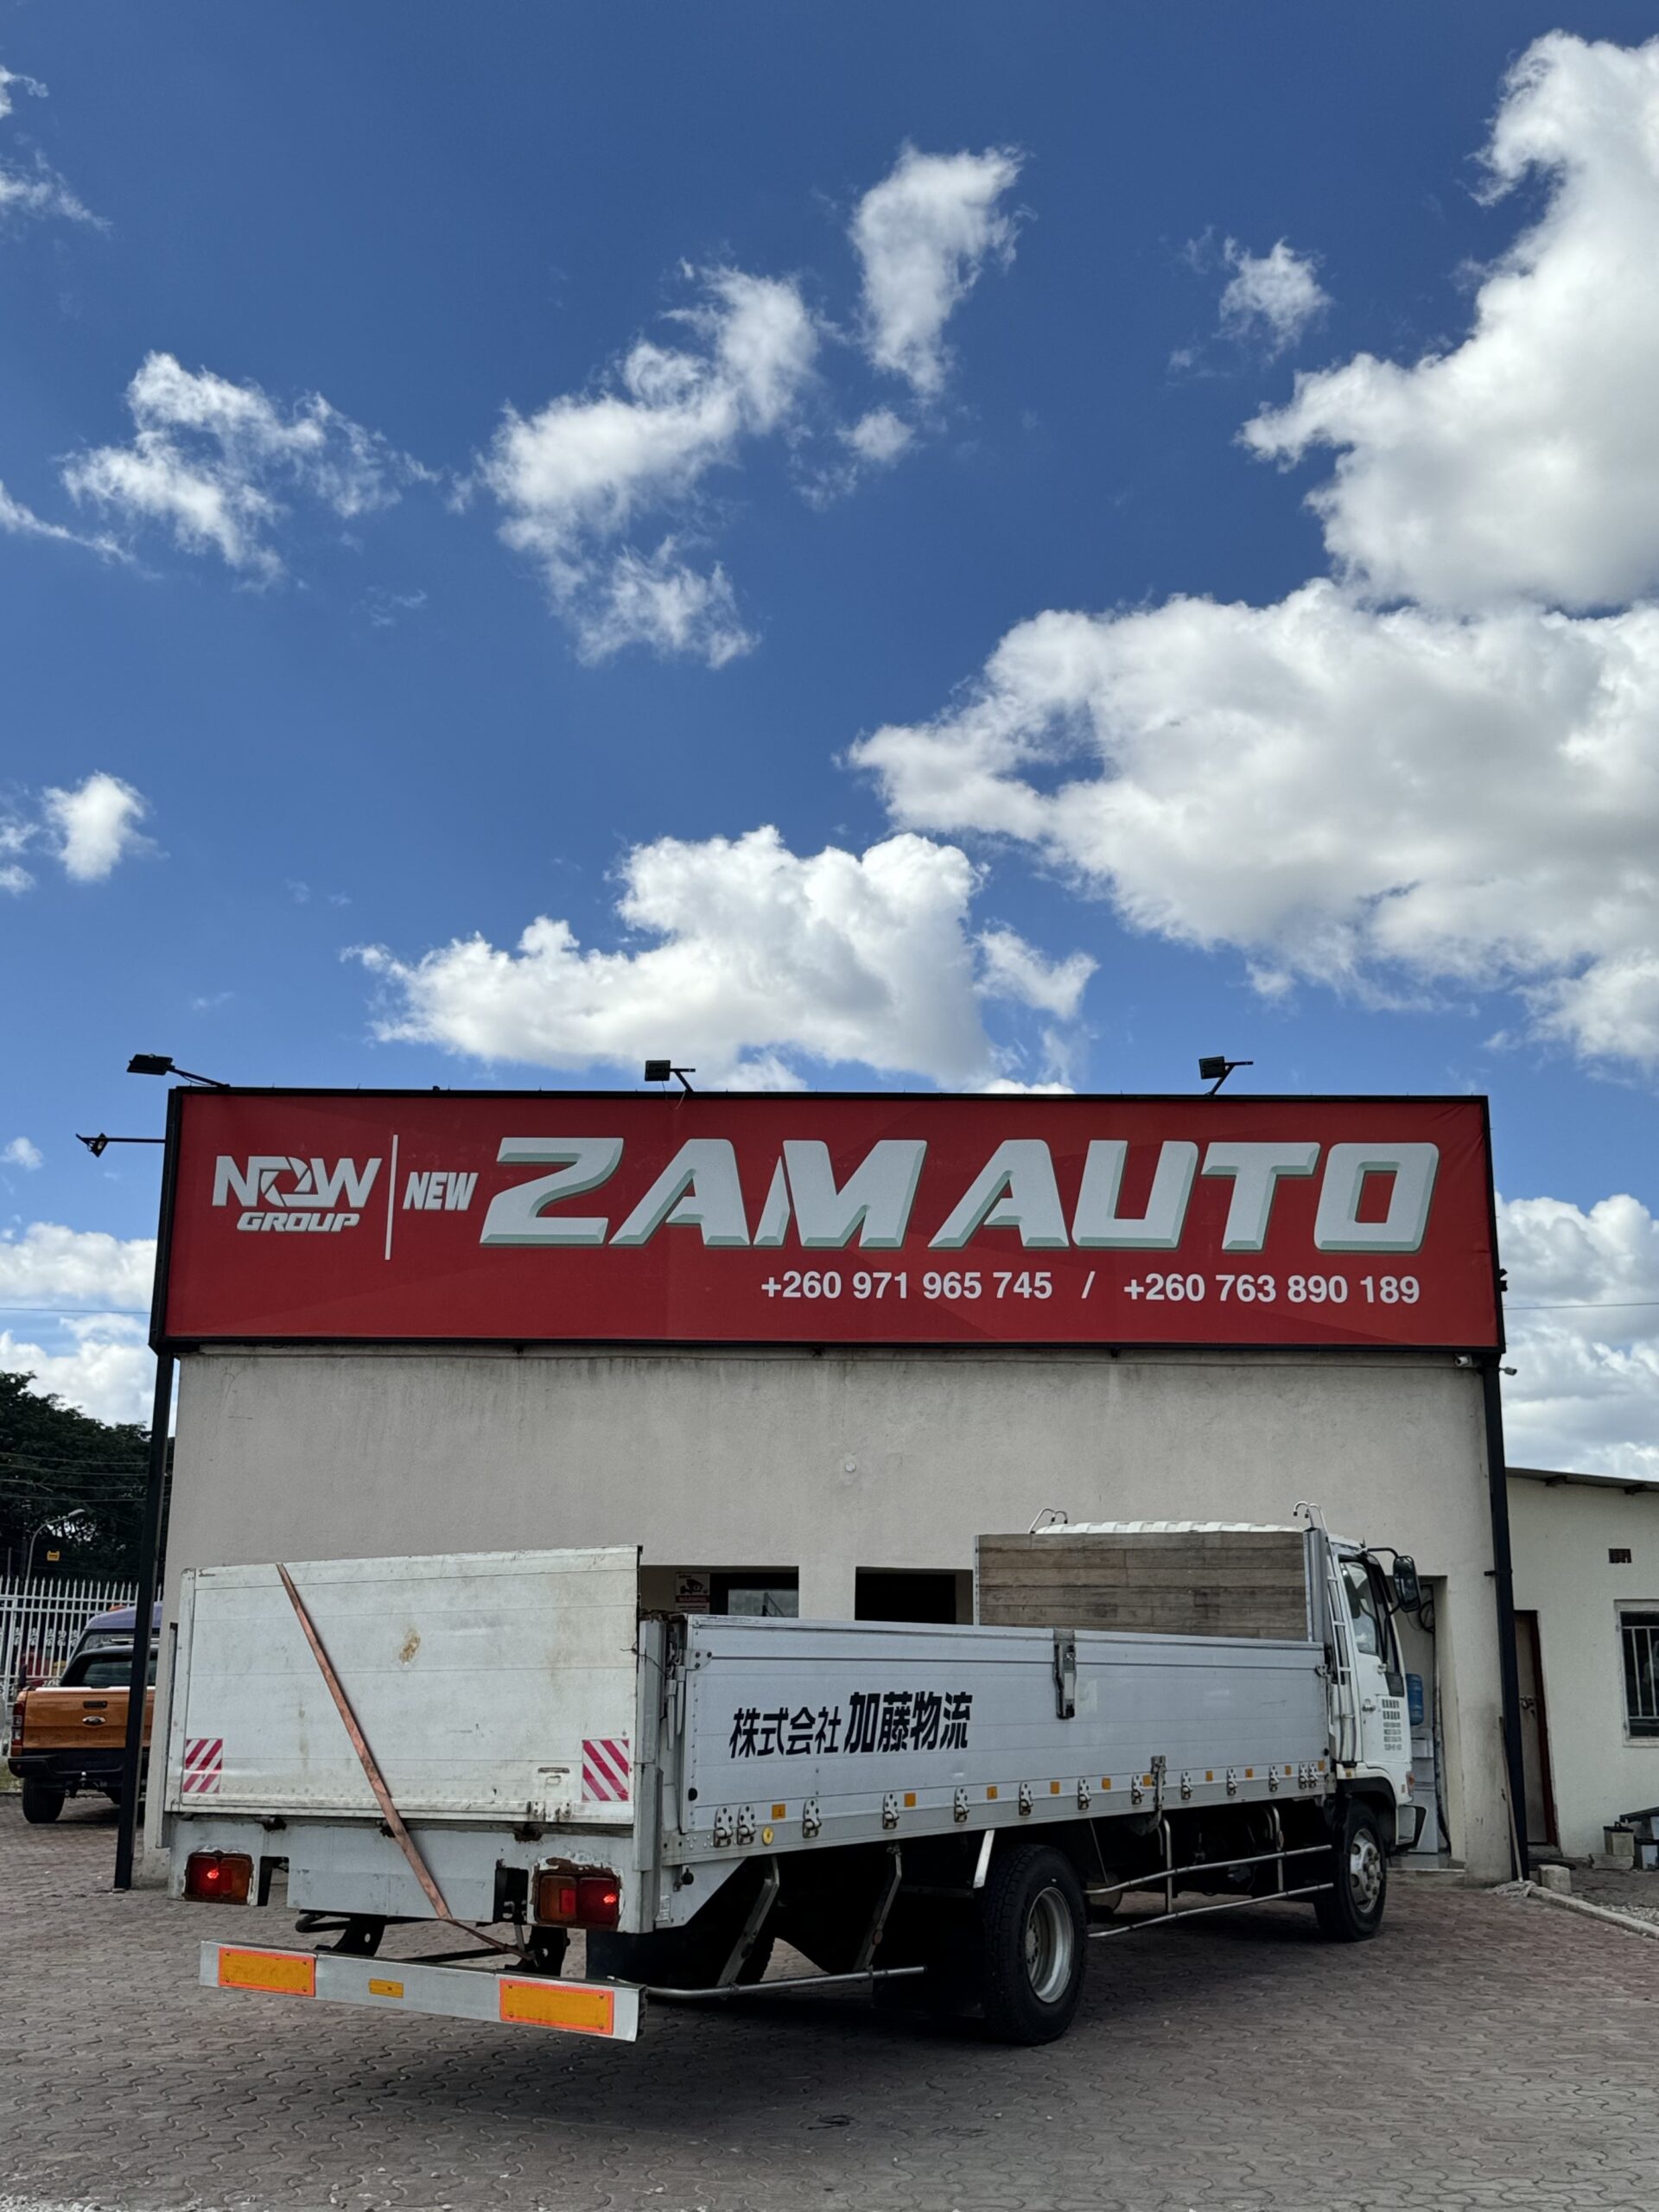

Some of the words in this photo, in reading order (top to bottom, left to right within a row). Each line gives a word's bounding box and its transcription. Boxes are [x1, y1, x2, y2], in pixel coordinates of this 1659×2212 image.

[402, 1172, 479, 1211] NEW
[236, 1211, 360, 1232] GROUP
[761, 1270, 842, 1300] +260
[852, 1271, 907, 1300] 971
[922, 1271, 982, 1300] 965
[992, 1271, 1053, 1300] 745
[1081, 1270, 1096, 1299] /
[1123, 1273, 1205, 1301] +260
[1215, 1274, 1277, 1303] 763
[1287, 1274, 1348, 1303] 890
[1359, 1275, 1421, 1304] 189
[728, 1691, 974, 1759] 株式会社加藤物流
